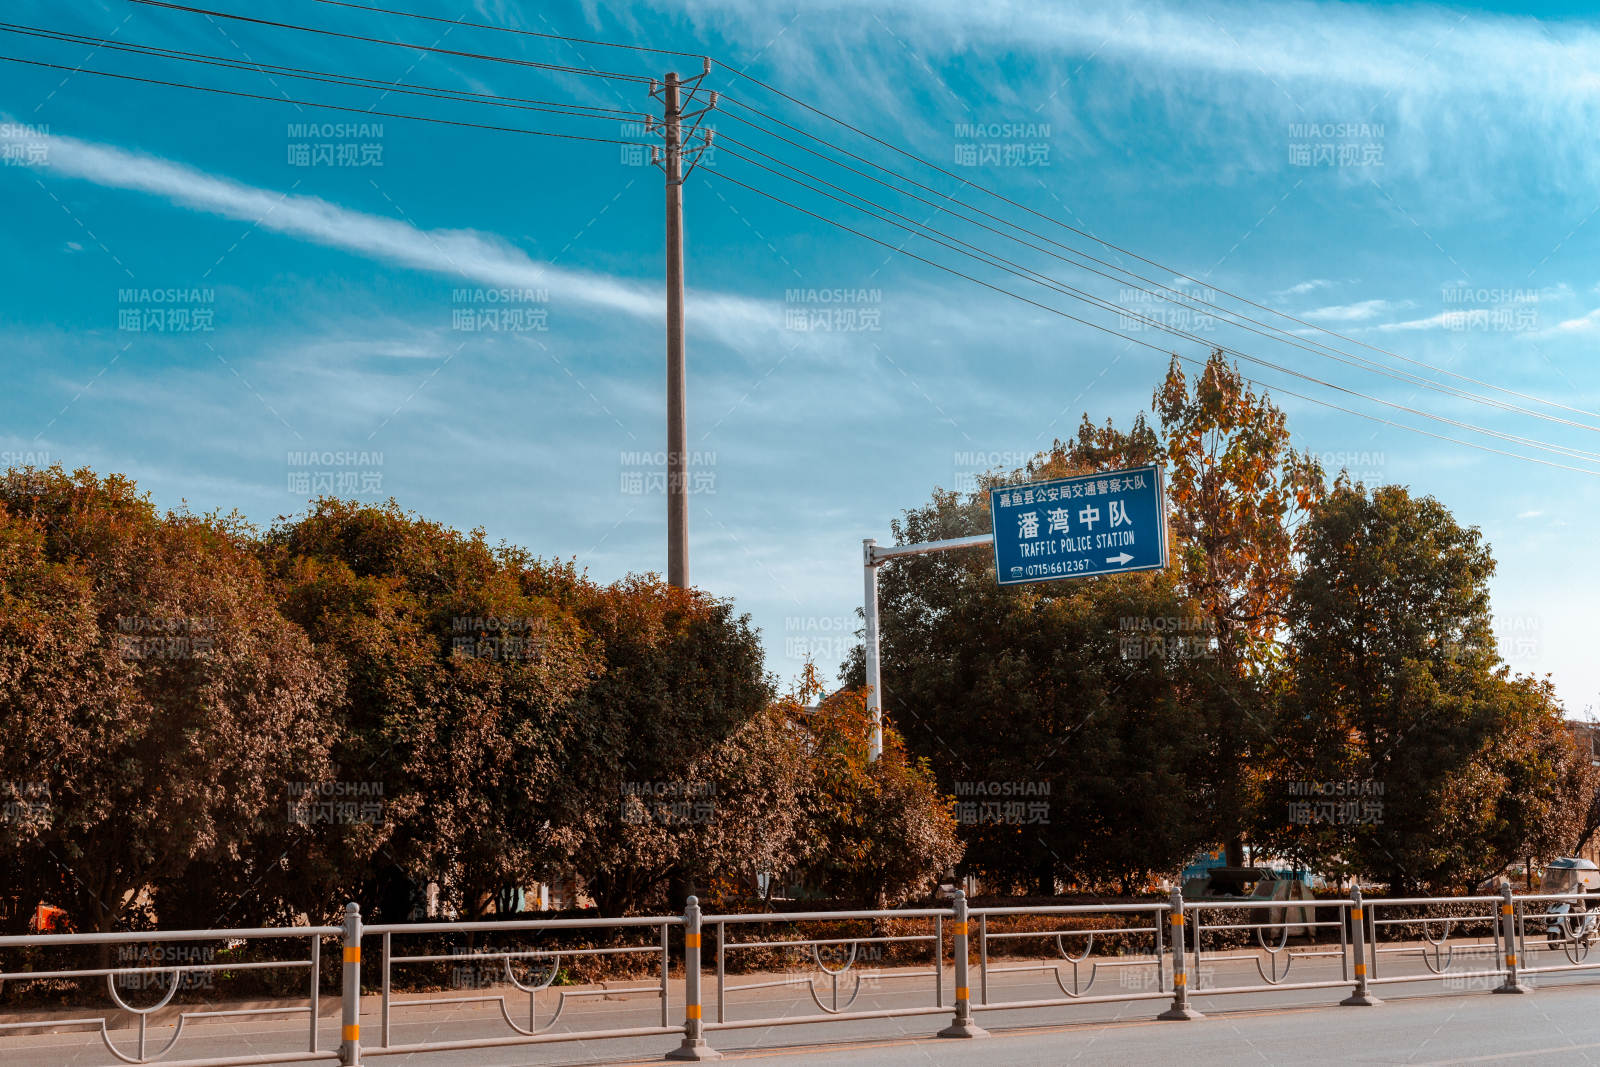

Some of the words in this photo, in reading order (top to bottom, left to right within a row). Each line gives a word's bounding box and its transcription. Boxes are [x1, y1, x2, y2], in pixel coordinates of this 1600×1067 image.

[1000, 475, 1147, 507] 嘉鱼县公安局交通警察大队
[1017, 500, 1132, 540] 潘湾中队
[1019, 541, 1057, 558] TRAFFIC
[1061, 536, 1092, 553] POLICE
[1096, 530, 1135, 549] STATION
